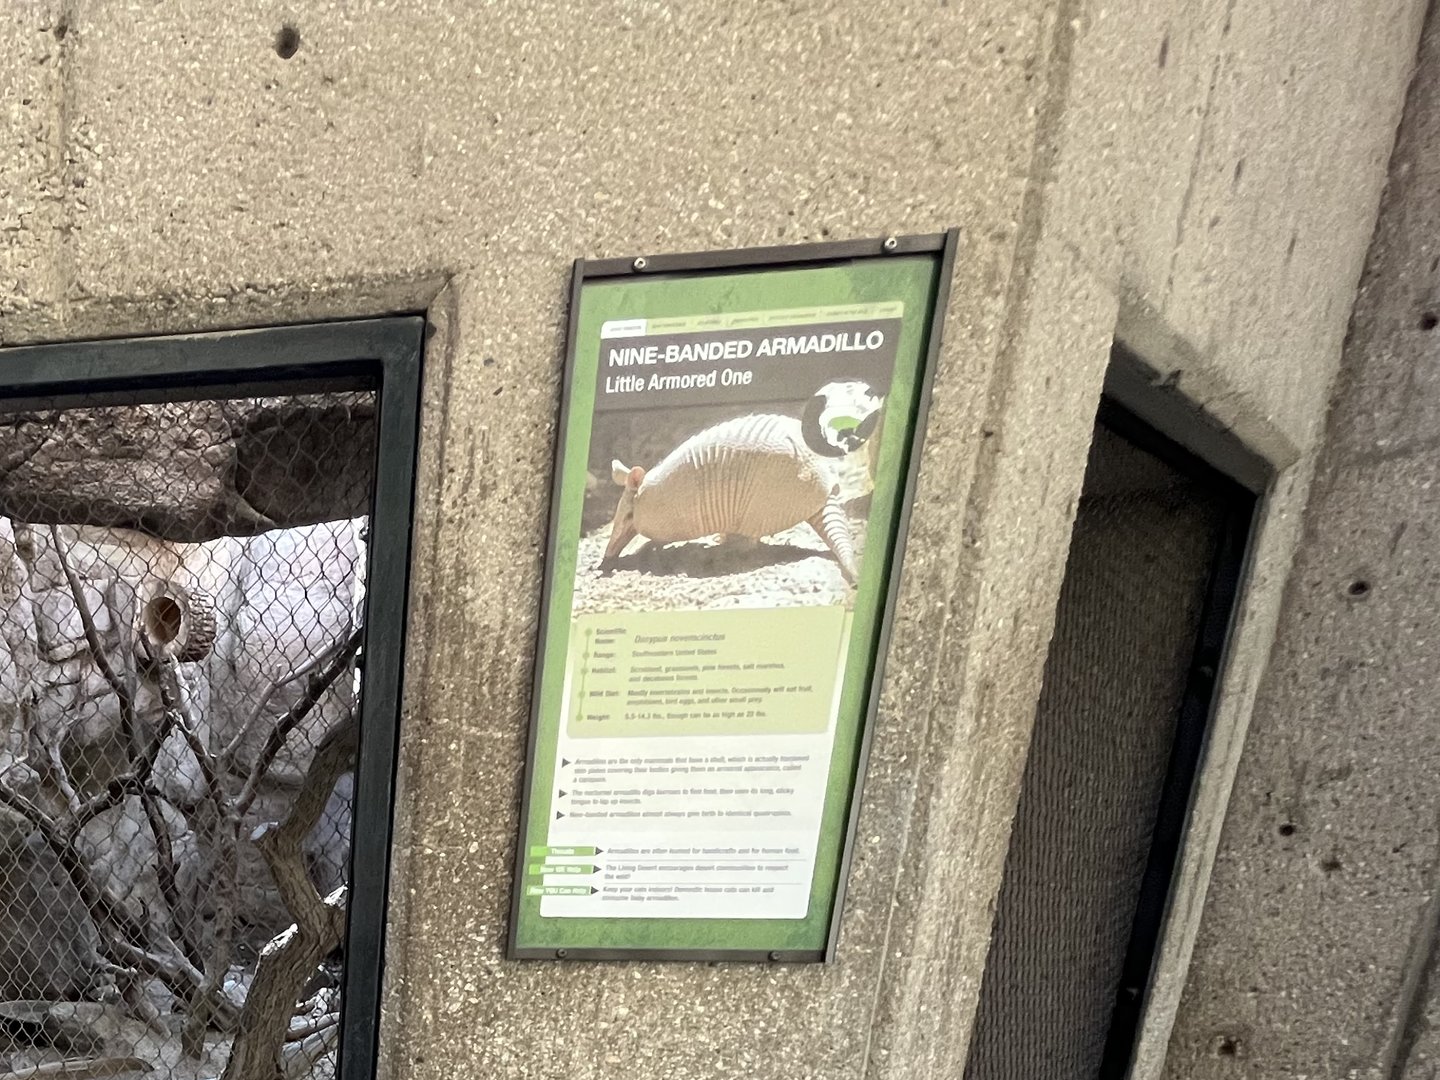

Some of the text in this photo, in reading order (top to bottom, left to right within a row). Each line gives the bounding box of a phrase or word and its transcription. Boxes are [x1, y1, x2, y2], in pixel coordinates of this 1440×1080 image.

[609, 330, 884, 366] NINE-BANDED ARMADILLO
[606, 368, 752, 393] Little Armored One
